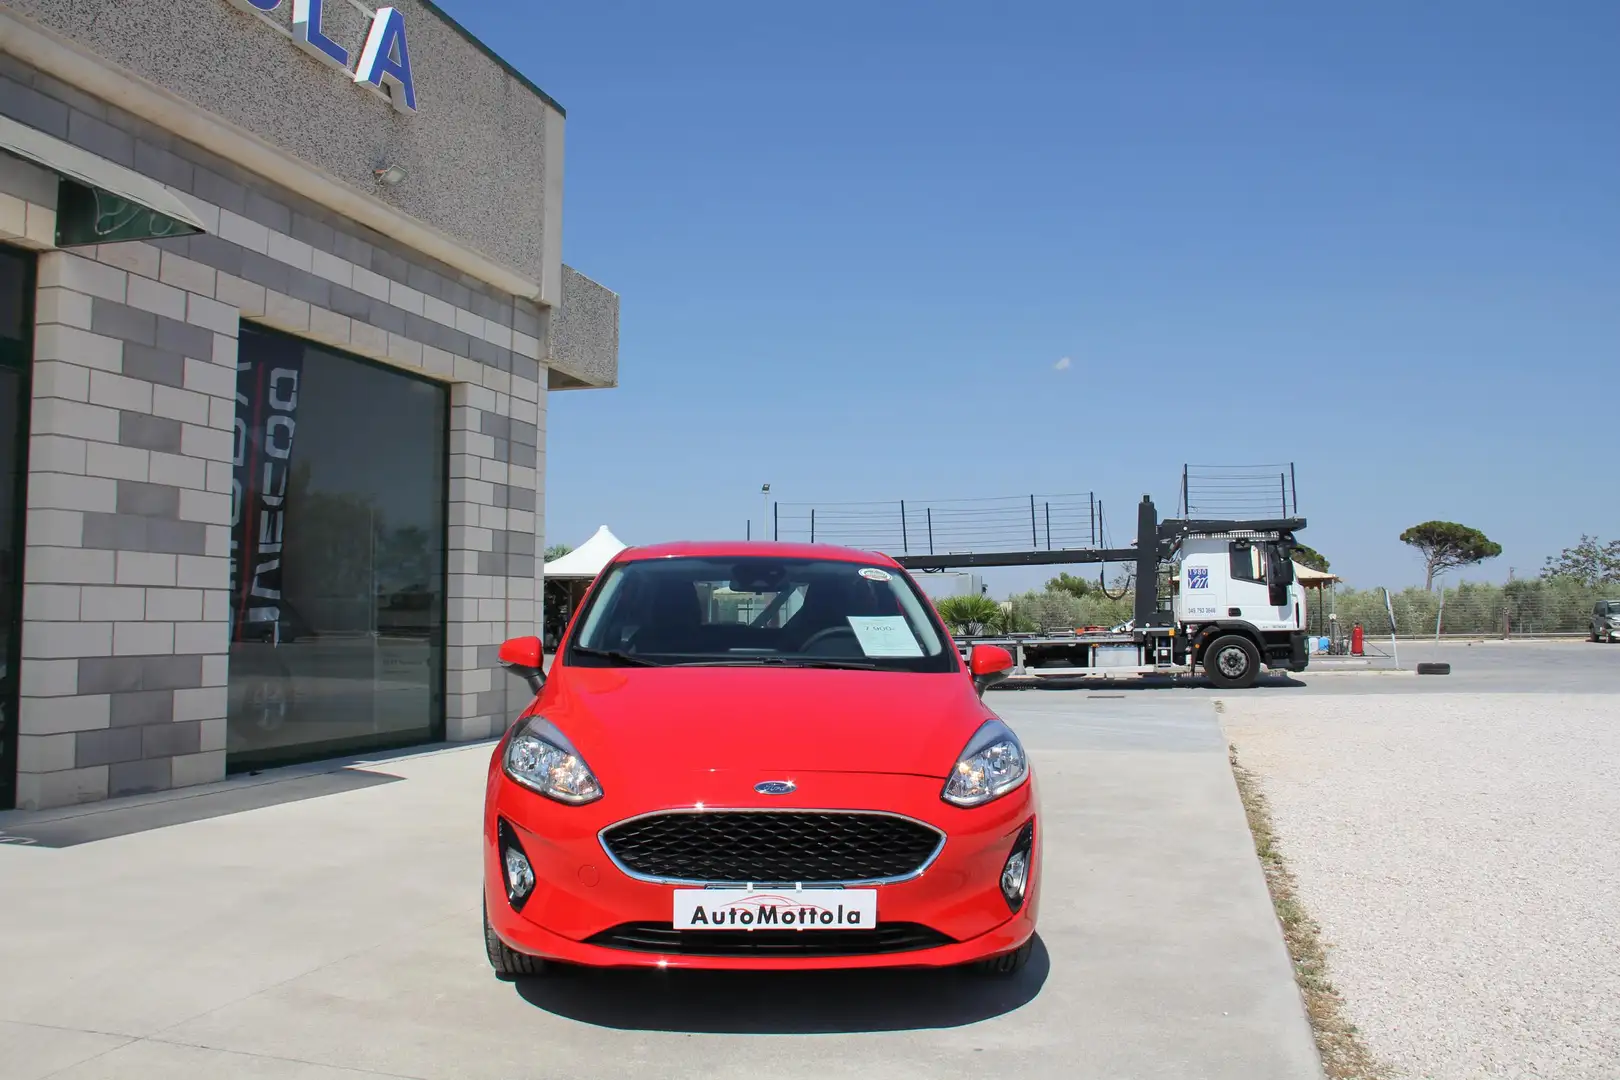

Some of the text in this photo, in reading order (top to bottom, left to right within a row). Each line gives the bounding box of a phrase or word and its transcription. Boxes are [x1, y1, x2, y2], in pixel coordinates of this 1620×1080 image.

[234, 0, 417, 113] LA
[249, 367, 298, 648] JAECOO
[691, 904, 861, 925] AutoMottola
